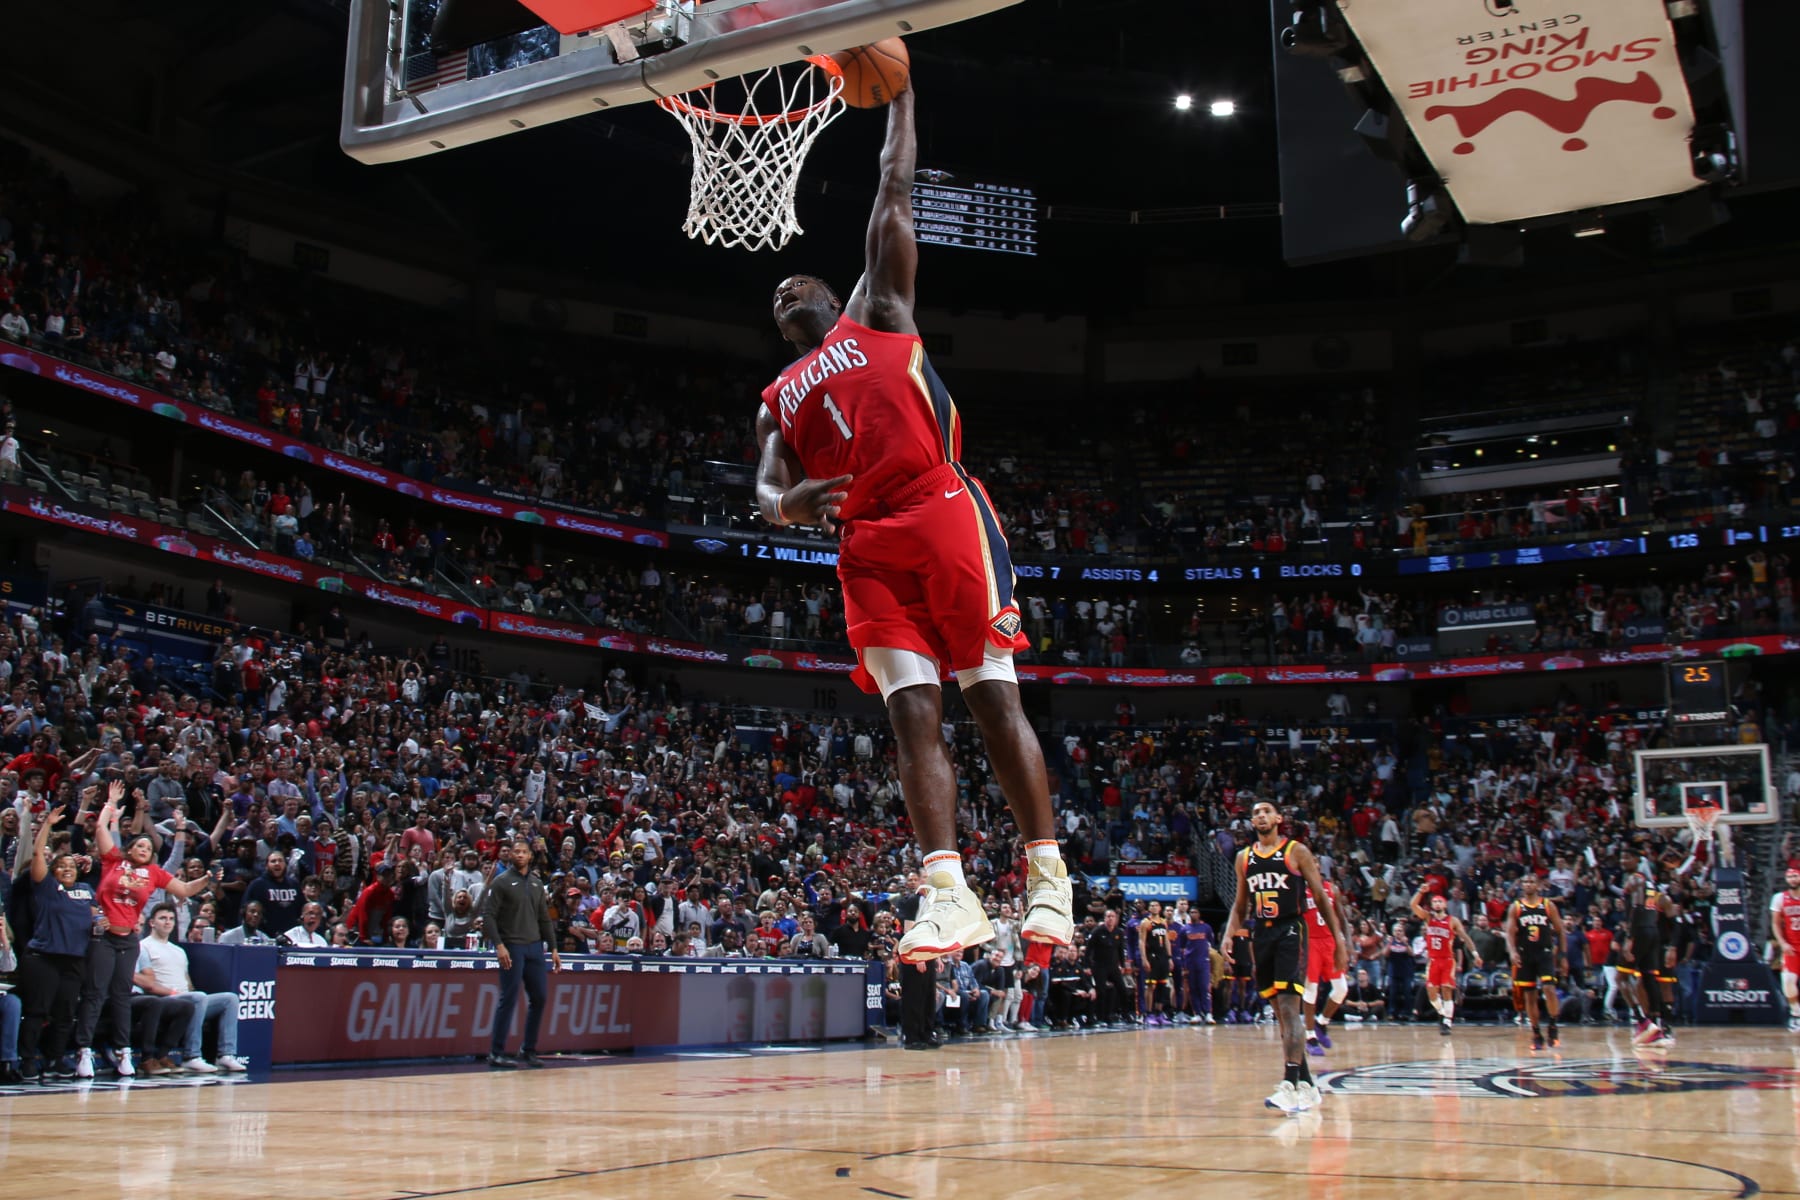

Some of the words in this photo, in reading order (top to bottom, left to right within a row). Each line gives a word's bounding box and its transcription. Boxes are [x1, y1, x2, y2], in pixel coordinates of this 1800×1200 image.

[1456, 14, 1582, 46] CENTER
[1408, 37, 1662, 99] SMOOTHIE
[779, 338, 868, 429] PELICANS
[822, 392, 853, 440] 1
[52, 504, 110, 531] SMOOTHIE
[1668, 533, 1699, 548] 126
[741, 543, 750, 557] 1
[774, 546, 841, 566] WILLIAM
[1014, 566, 1044, 578] NDS
[1050, 567, 1061, 579] 7
[1082, 568, 1142, 581] ASSISTS
[1147, 569, 1159, 582] 4
[1185, 567, 1243, 580] STEALS
[1251, 567, 1261, 580] 1
[1280, 564, 1343, 578] BLOCKS
[1351, 563, 1362, 577] 0
[1119, 882, 1190, 896] FANDUEL
[1246, 871, 1291, 894] PHX
[268, 888, 298, 902] NOP
[1255, 891, 1280, 919] 15
[1519, 914, 1549, 927] PHX
[1527, 925, 1540, 942] 3
[286, 956, 316, 967] SEATGEEK
[330, 957, 359, 968] SEATGEEK
[372, 958, 400, 968] SEATGEEK
[412, 960, 438, 969] SEATGEEK
[450, 961, 475, 969] SEATGEEK
[239, 980, 276, 1001] SEAT
[867, 983, 882, 997] SEAT
[1704, 989, 1771, 1004] TISSOT
[237, 1000, 276, 1021] GEEK
[867, 996, 883, 1010] GEEK
[346, 981, 465, 1042] GAME
